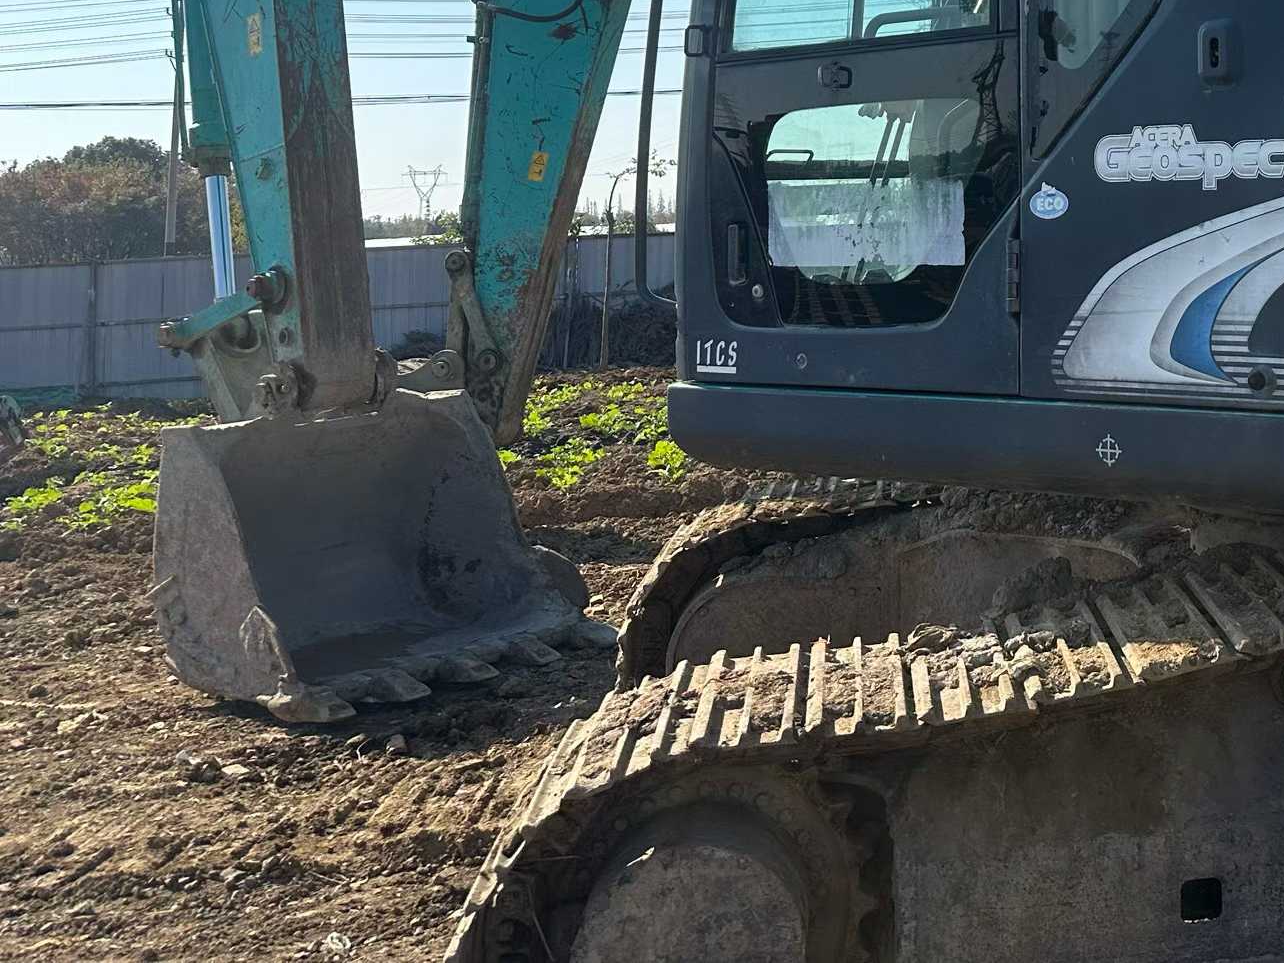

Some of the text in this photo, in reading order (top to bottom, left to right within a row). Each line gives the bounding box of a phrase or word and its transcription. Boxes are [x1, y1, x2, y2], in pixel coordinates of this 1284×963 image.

[1128, 124, 1198, 150] ACERA
[1036, 197, 1064, 211] ECO
[696, 339, 738, 366] ITCS
